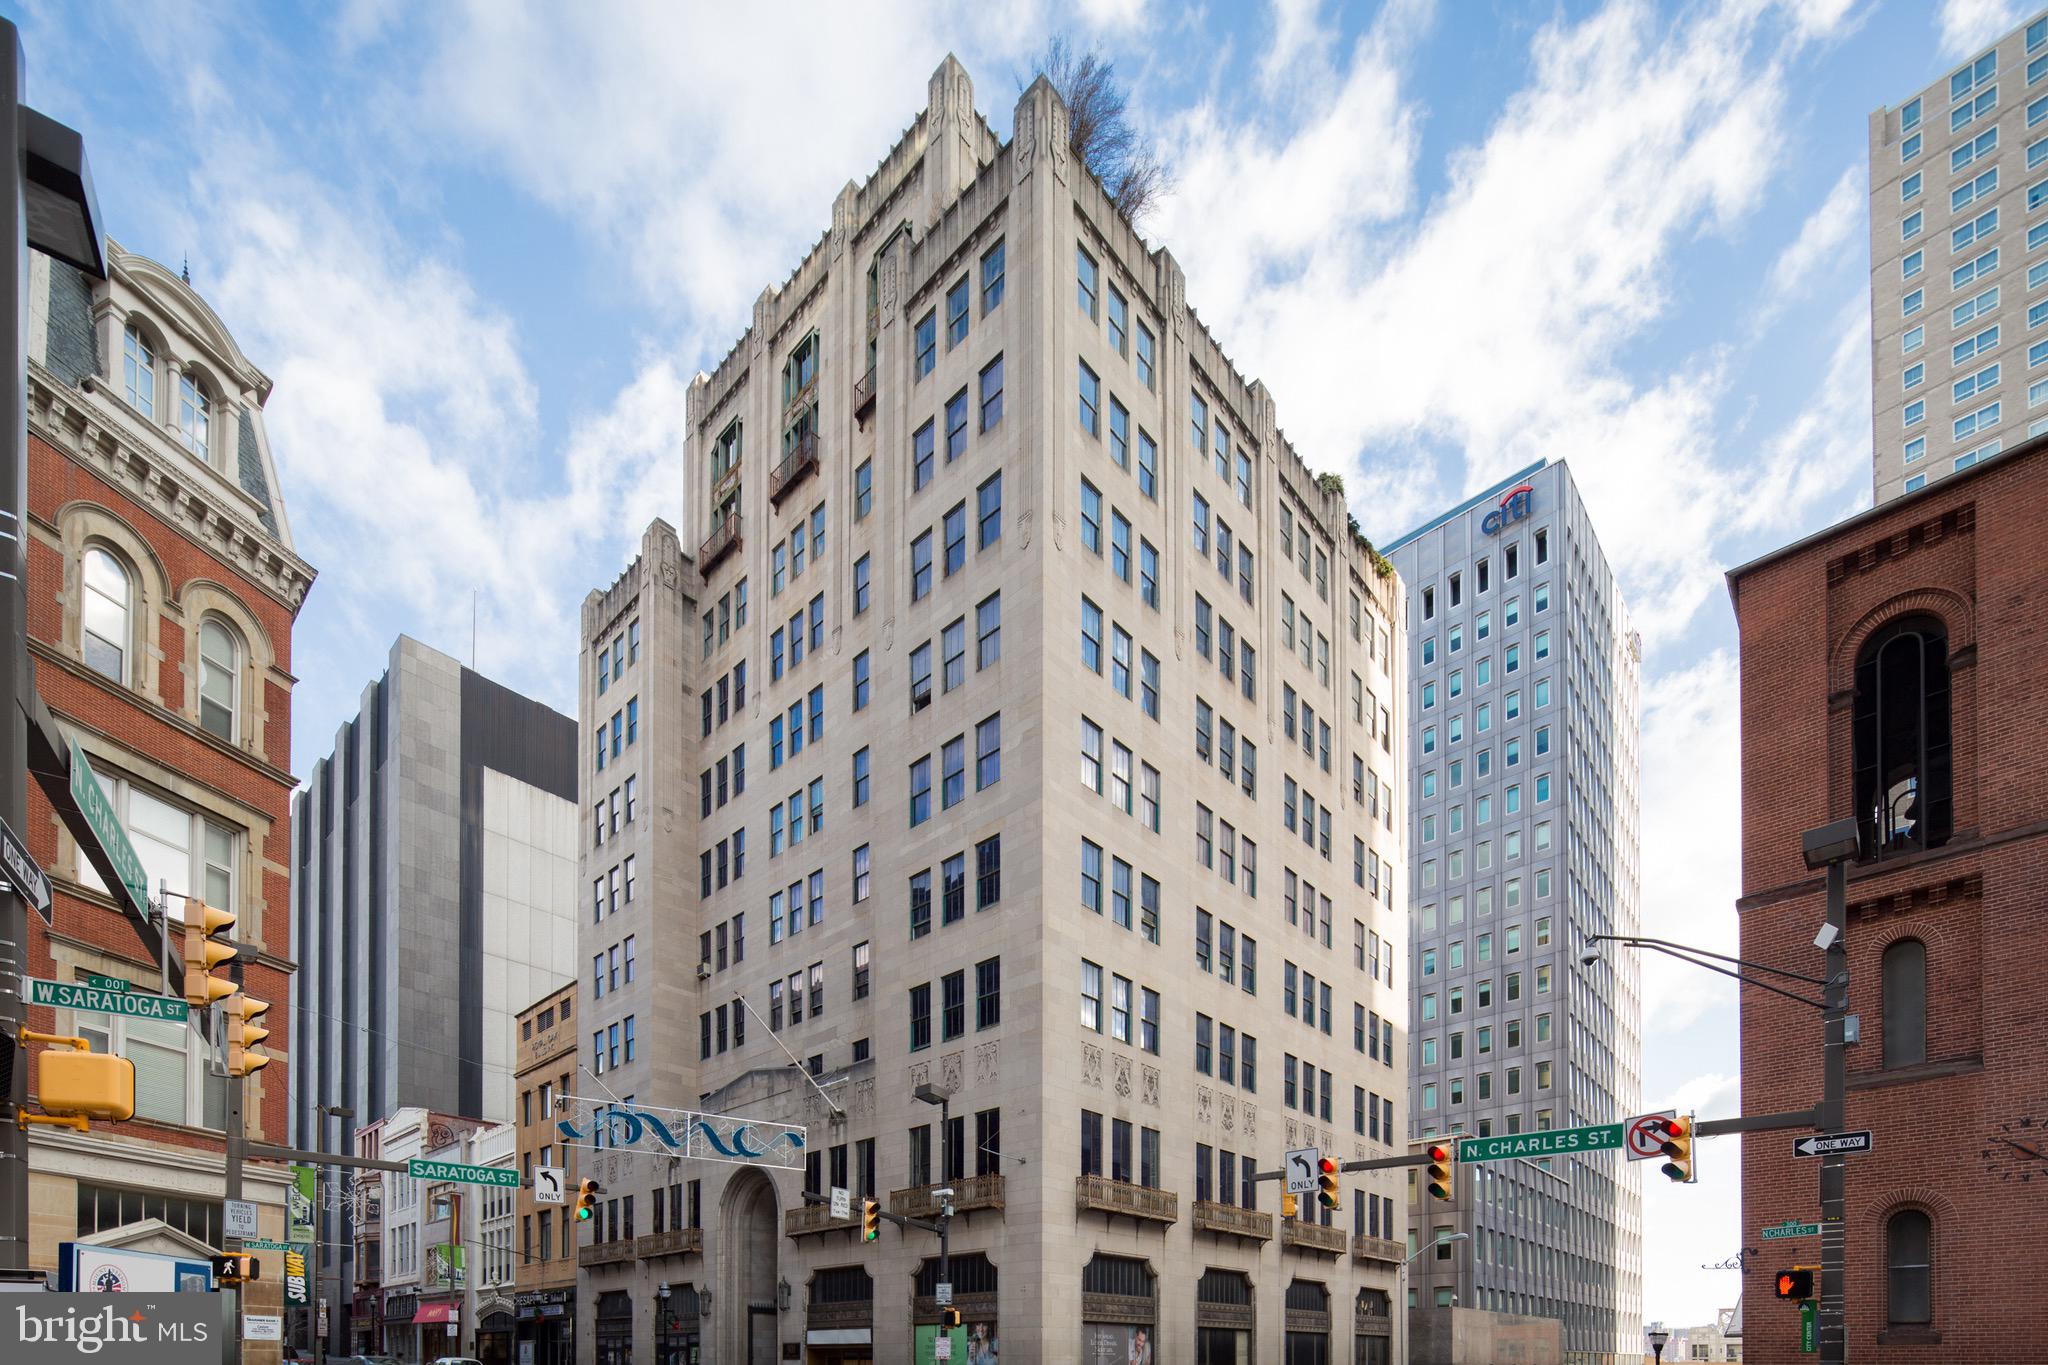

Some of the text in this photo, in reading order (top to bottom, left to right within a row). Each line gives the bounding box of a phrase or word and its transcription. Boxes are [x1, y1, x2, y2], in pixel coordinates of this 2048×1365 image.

[1481, 486, 1533, 536] citi
[88, 783, 133, 881] CHARLES
[5, 841, 39, 893] ONE WAY
[105, 979, 125, 990] 001
[37, 983, 182, 1017] W. SARATOGA ST.
[1467, 1130, 1615, 1158] N. CHARLES ST.
[1816, 1138, 1862, 1151] ONE WAY
[413, 1162, 516, 1184] SARATOGA ST.
[1291, 1179, 1315, 1191] ONLY
[538, 1192, 561, 1201] ONLY
[231, 1214, 252, 1224] YIELD
[1769, 1226, 1807, 1237] CHARLES
[251, 1242, 283, 1250] SARATOGA
[286, 1248, 307, 1304] SUBWAY
